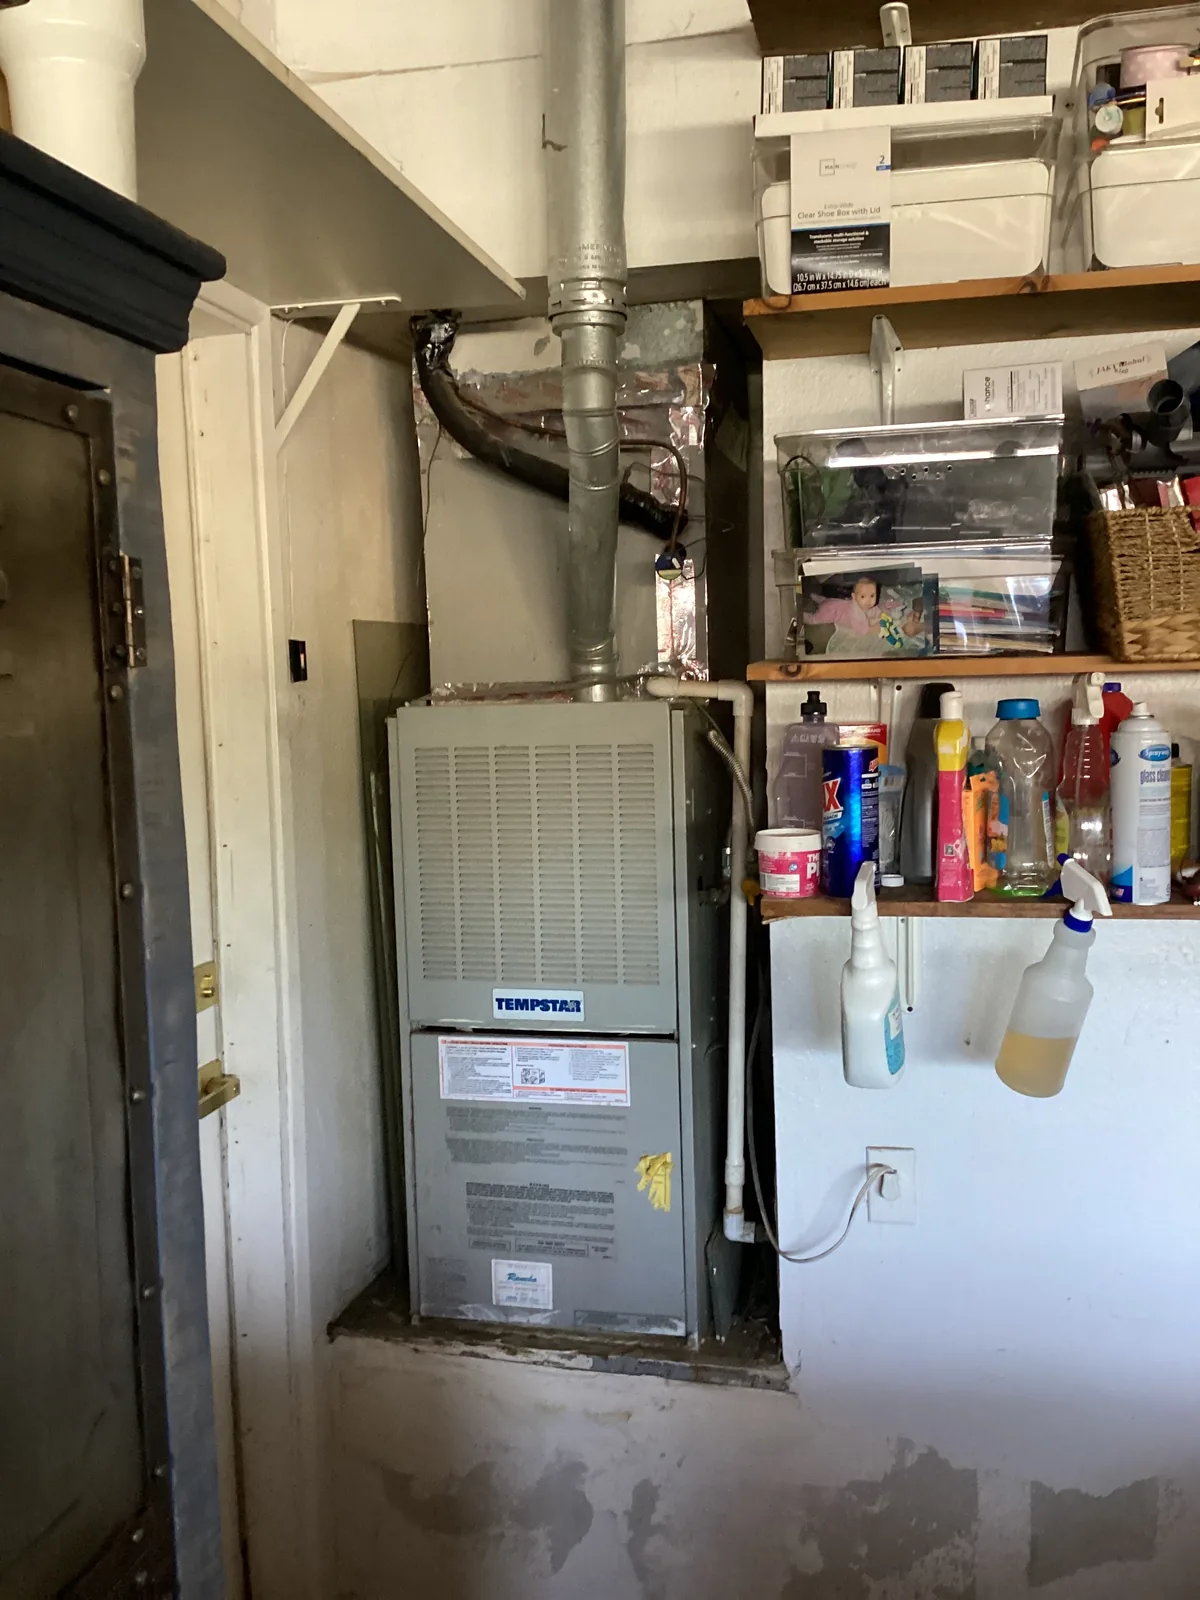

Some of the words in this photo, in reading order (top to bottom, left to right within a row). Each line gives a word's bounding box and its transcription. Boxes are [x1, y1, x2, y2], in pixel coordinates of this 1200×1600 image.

[879, 155, 885, 164] 2
[798, 211, 815, 219] Clear
[817, 210, 835, 218] Shoe
[836, 209, 850, 217] Box
[851, 207, 868, 215] with
[870, 206, 881, 214] Lid
[797, 273, 808, 282] 10.5
[815, 273, 822, 281] W
[821, 281, 832, 290] 37.5
[847, 279, 859, 288] 14.6
[870, 277, 886, 286] each
[1140, 770, 1156, 785] glass
[495, 998, 581, 1012] TEMPSTAR
